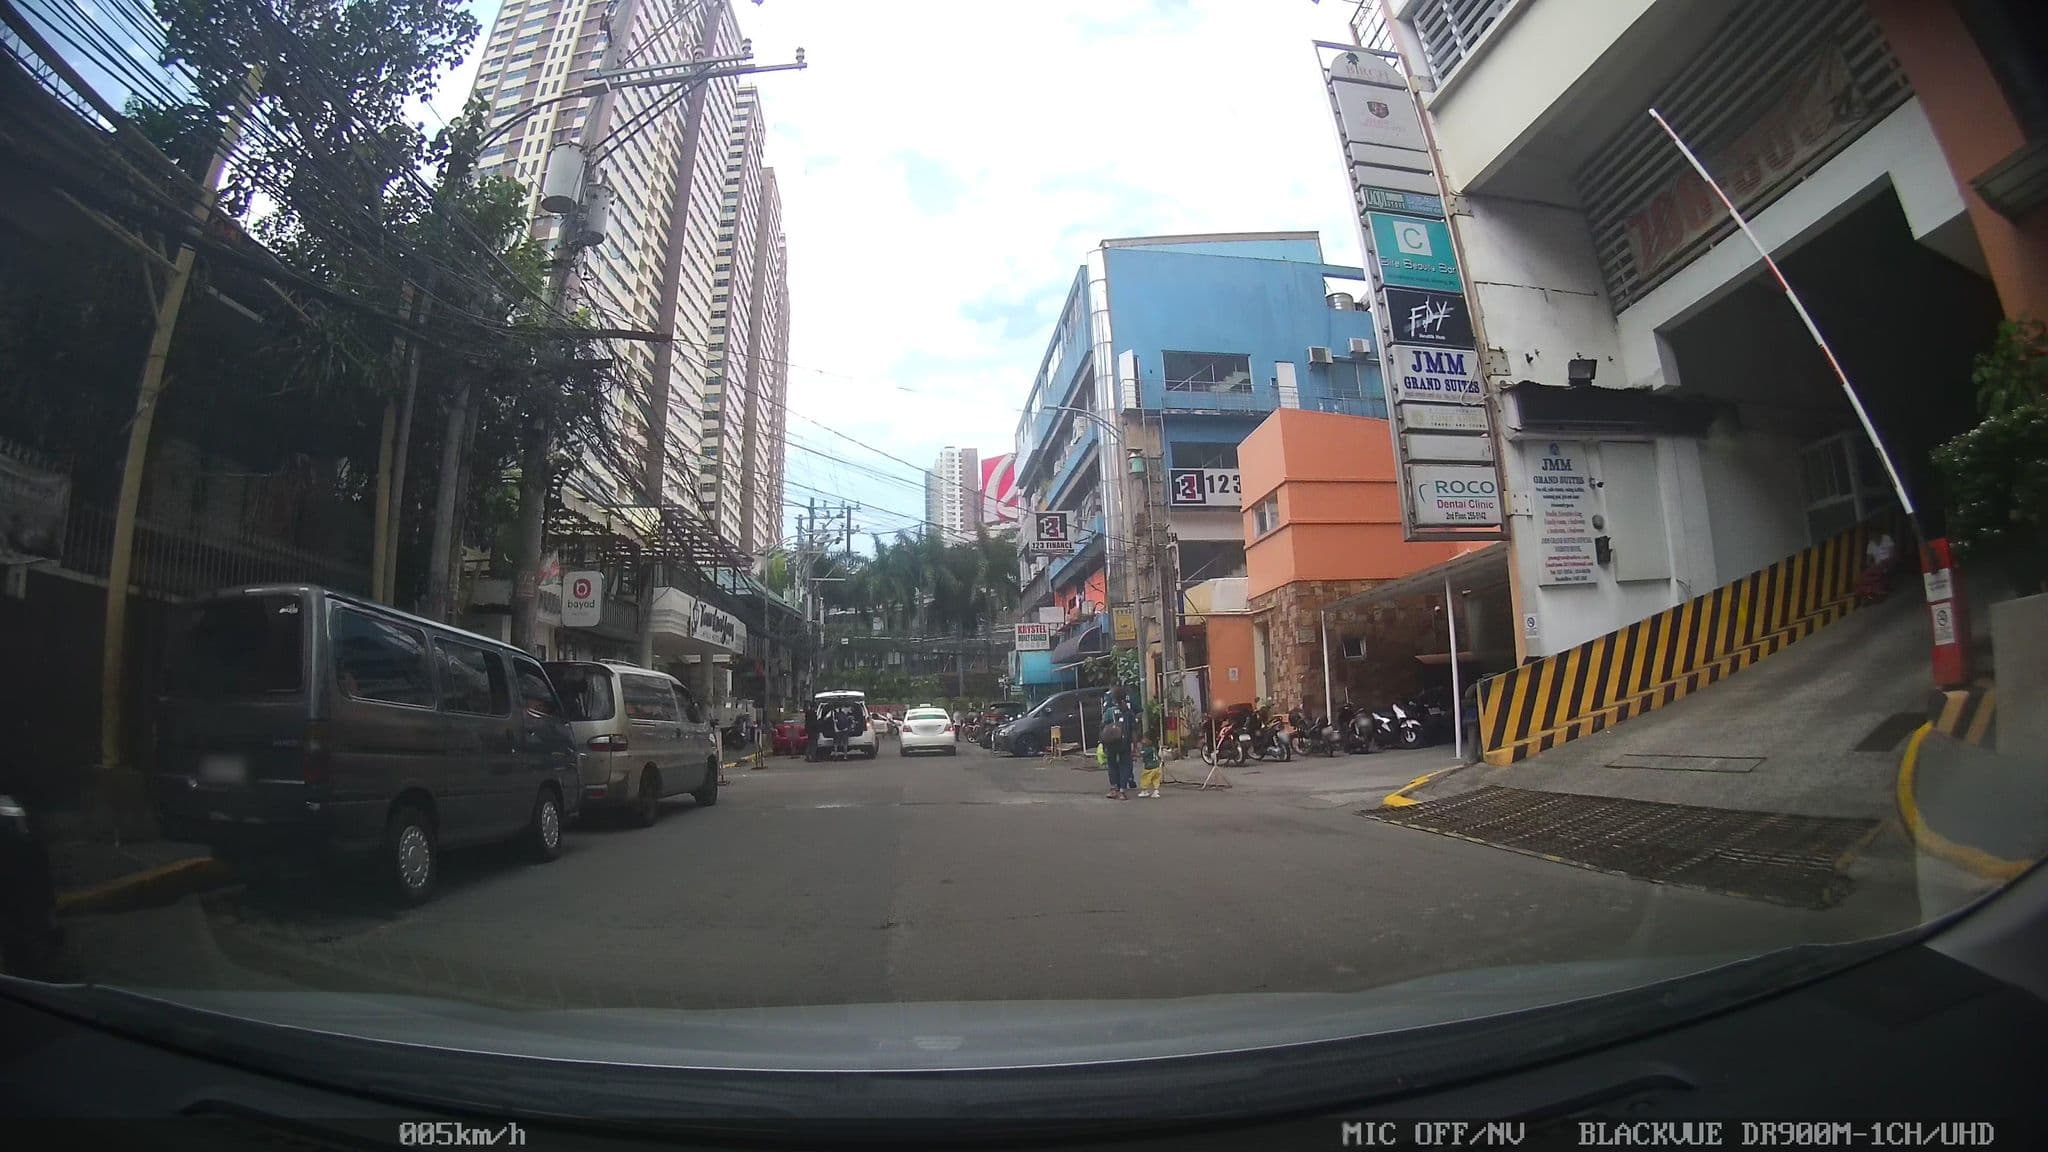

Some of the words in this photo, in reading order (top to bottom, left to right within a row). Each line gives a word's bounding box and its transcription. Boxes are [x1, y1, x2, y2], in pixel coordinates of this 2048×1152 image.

[1403, 227, 1423, 250] C
[1411, 350, 1467, 376] JMM
[1404, 376, 1441, 391] GRAND
[1445, 379, 1480, 394] SUITES
[1542, 458, 1573, 472] JMM
[1435, 480, 1495, 494] ROCO
[1533, 475, 1559, 485] GRAND
[1560, 476, 1585, 485] SUITES
[1437, 499, 1466, 509] Dental
[1468, 499, 1494, 509] Clinic
[1032, 542, 1044, 550] 123
[1046, 541, 1073, 550] FINANCE
[567, 599, 595, 610] bayad
